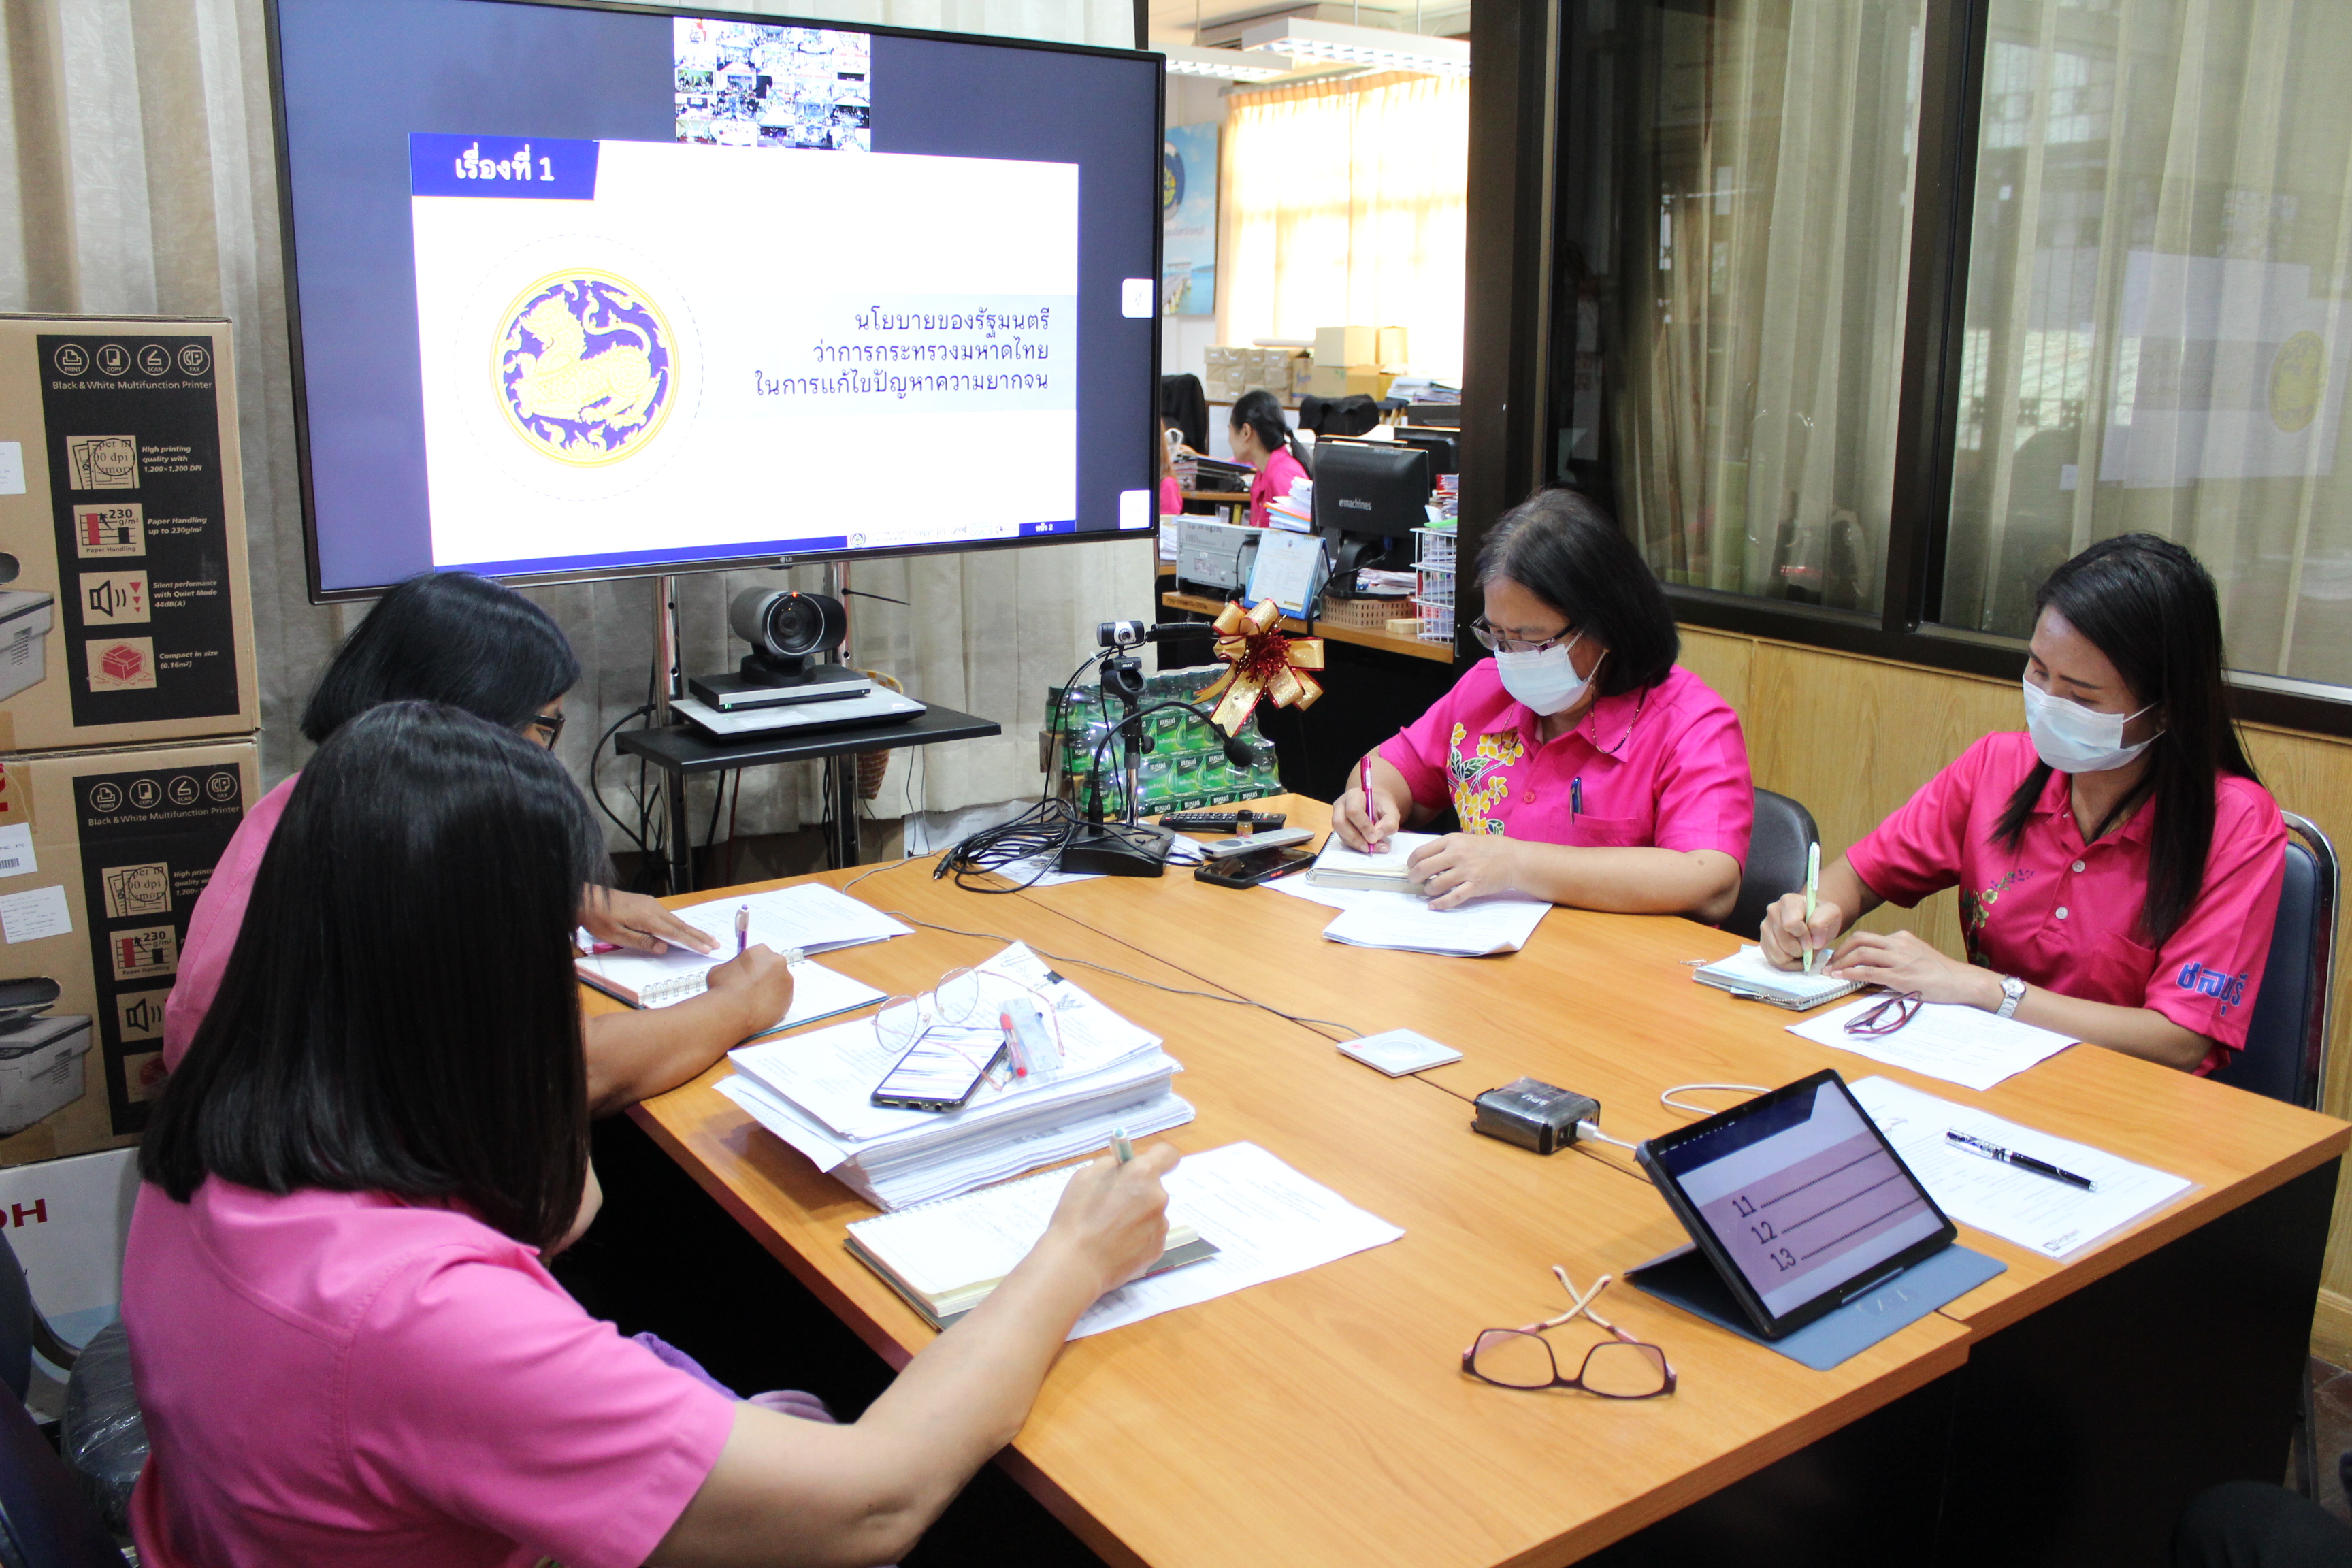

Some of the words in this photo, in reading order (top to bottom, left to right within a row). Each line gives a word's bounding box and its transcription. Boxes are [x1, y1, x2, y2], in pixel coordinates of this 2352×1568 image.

[455, 142, 532, 181] เรื่องที่
[539, 157, 555, 181] 1
[855, 306, 1050, 338] นโยบายของรัฐมนตรี
[813, 336, 1049, 362] ว่าการกระทรวงมหาดไทย
[52, 381, 76, 389] Black
[87, 381, 115, 389] White
[118, 381, 180, 389] Multifunction
[182, 381, 212, 389] Printer
[754, 368, 1049, 399] ในการแก้ไขปัญหาความยากจน
[161, 446, 191, 454] printing
[110, 452, 128, 463] dpi
[109, 509, 133, 519] 230
[148, 518, 169, 526] Paper
[174, 581, 218, 589] performance
[159, 652, 193, 660] Compact
[1160, 717, 1176, 726] แบรนด์
[1180, 757, 1196, 766] แบรนด์
[1209, 753, 1224, 762] แบรนด์
[1150, 762, 1166, 770] แบรนด์
[1213, 795, 1229, 804] แบรนด์
[1242, 791, 1258, 800] แบรนด์
[1154, 804, 1171, 812] แบรนด์
[1184, 799, 1200, 808] แบรนด์
[88, 817, 112, 826] Black
[120, 815, 148, 823] White
[150, 809, 209, 821] Multifunction
[211, 806, 240, 814] Printer
[191, 868, 215, 877] printin
[144, 878, 161, 890] dpi
[174, 879, 199, 887] quality
[143, 931, 166, 941] 230
[2176, 960, 2249, 1017] ชลบุรี
